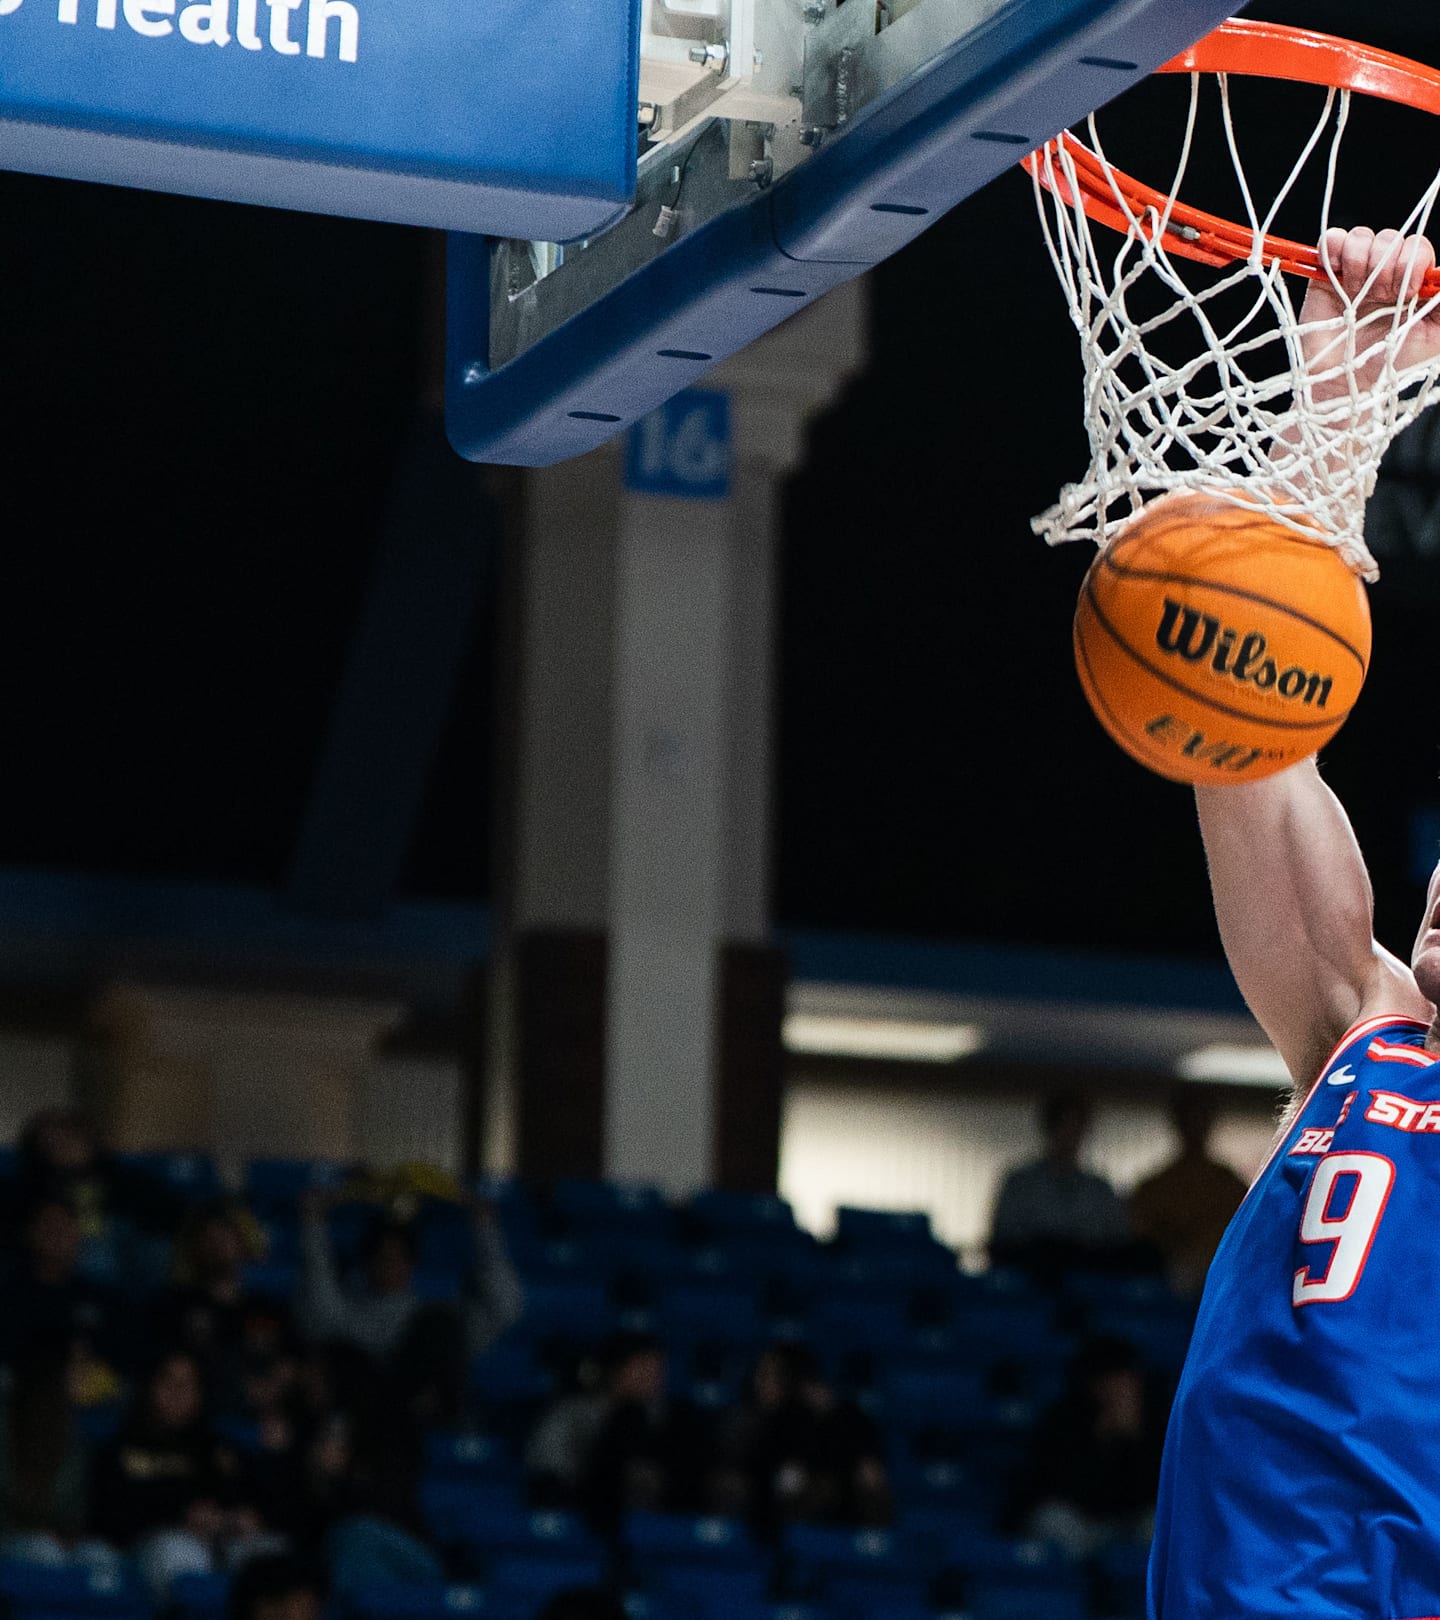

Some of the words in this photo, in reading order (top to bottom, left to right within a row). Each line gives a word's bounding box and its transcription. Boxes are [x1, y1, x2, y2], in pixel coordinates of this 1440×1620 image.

[58, 0, 359, 63] ealth
[642, 406, 732, 480] 16
[1156, 597, 1334, 710] Wilson
[1293, 1151, 1396, 1306] 9
